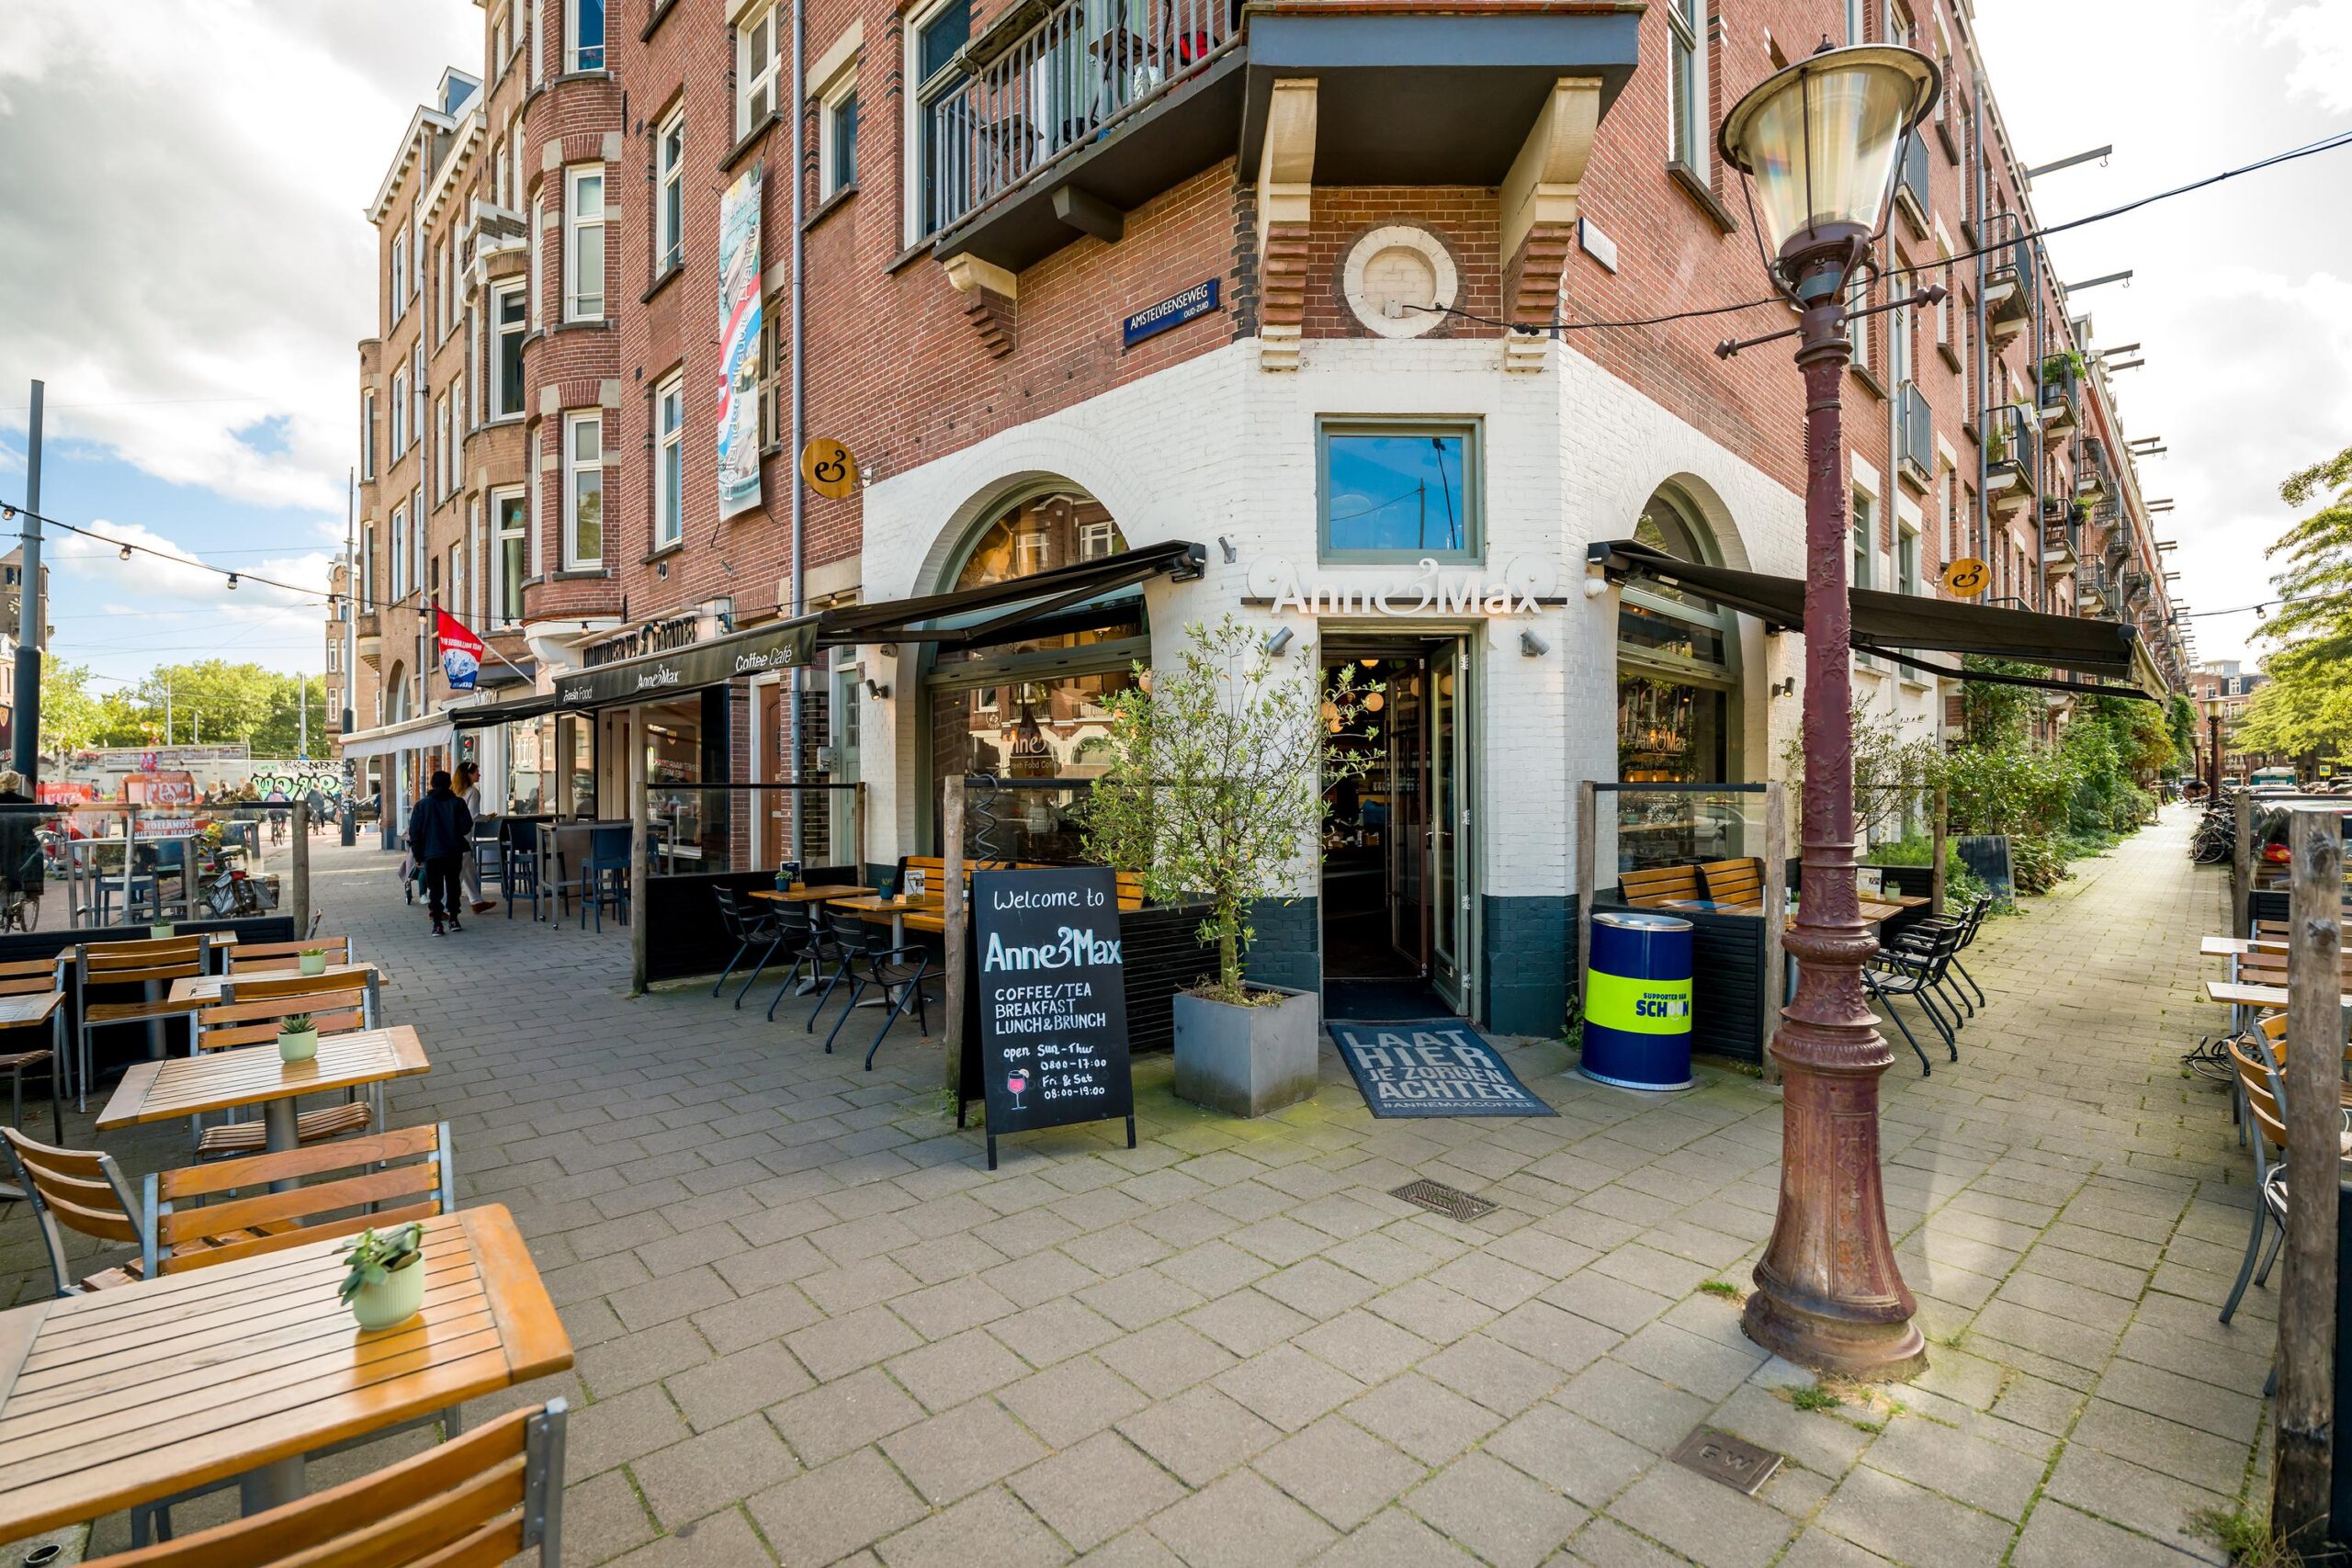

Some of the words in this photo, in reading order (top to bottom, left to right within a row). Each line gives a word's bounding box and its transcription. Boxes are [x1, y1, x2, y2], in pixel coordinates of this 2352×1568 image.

[1130, 284, 1208, 331] AMSTELVEENSEWEG
[1183, 300, 1209, 319] OUD-ZUID
[724, 396, 741, 502] Hollandse
[738, 223, 760, 303] Haring
[736, 653, 768, 673] Coffee
[769, 644, 792, 666] Café
[579, 686, 593, 700] Food
[1024, 761, 1040, 770] Food
[993, 890, 1080, 910] Welcome
[1087, 887, 1104, 907] to
[995, 982, 1092, 1001] COFFEE/TEA
[1643, 992, 1678, 1000] SUPPORTER
[995, 998, 1076, 1020] BREAKFAST
[1342, 1030, 1471, 1048] LAAT
[1003, 1046, 1030, 1063] open
[1352, 1046, 1497, 1069] HIER
[1042, 1077, 1057, 1088] Fri
[1062, 1074, 1071, 1087] &
[1073, 1074, 1093, 1085] Sat
[1369, 1067, 1394, 1082] JE
[1399, 1066, 1509, 1085] ZORGEN
[1377, 1080, 1527, 1100] ACHTER
